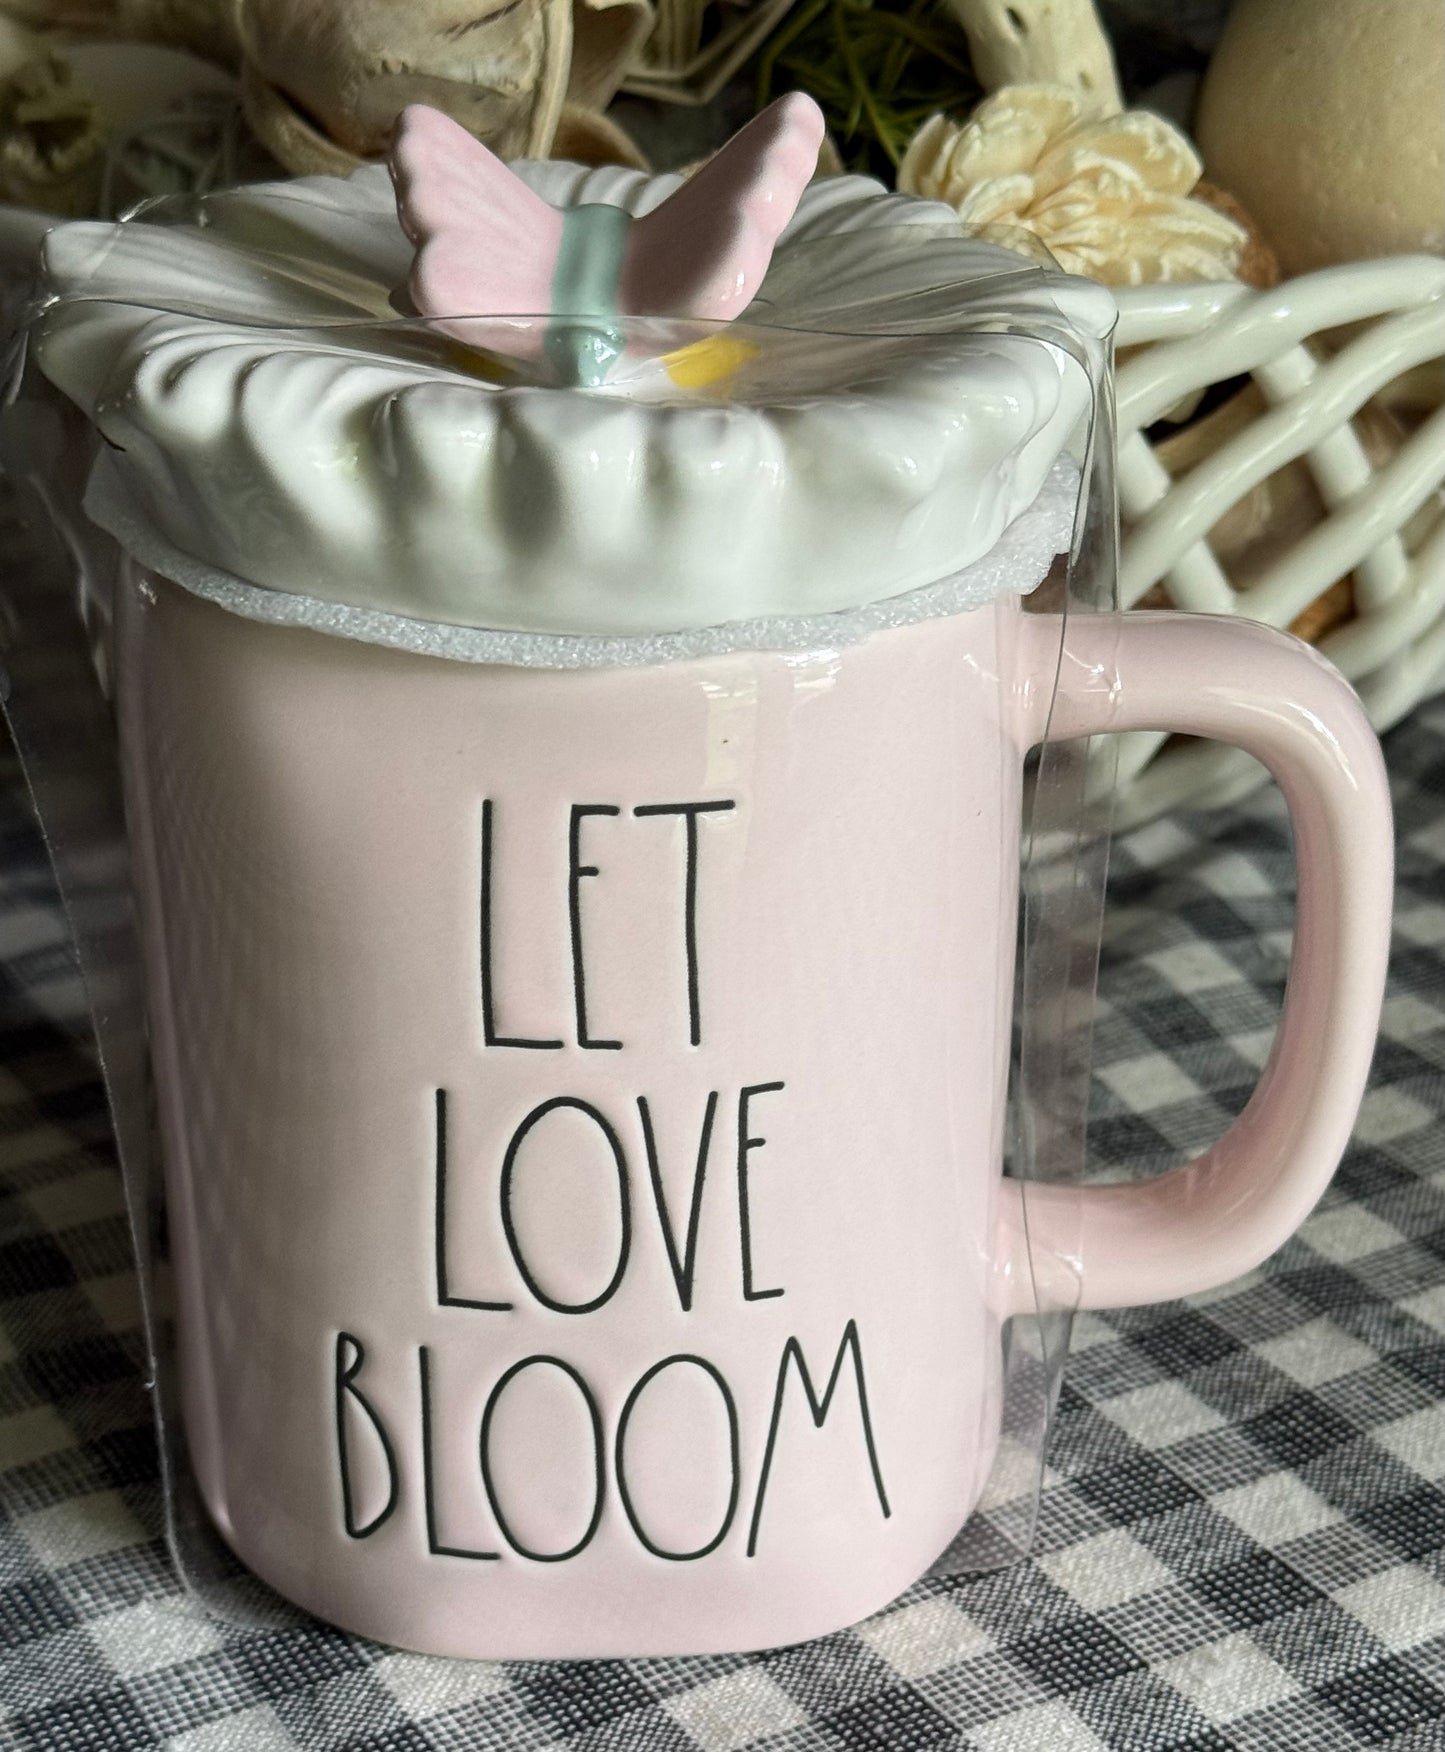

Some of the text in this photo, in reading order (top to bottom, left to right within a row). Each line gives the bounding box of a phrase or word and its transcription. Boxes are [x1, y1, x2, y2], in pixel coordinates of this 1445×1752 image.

[481, 799, 735, 1050] LET
[436, 1082, 784, 1314] LOVE
[335, 1320, 890, 1562] BLOOM
